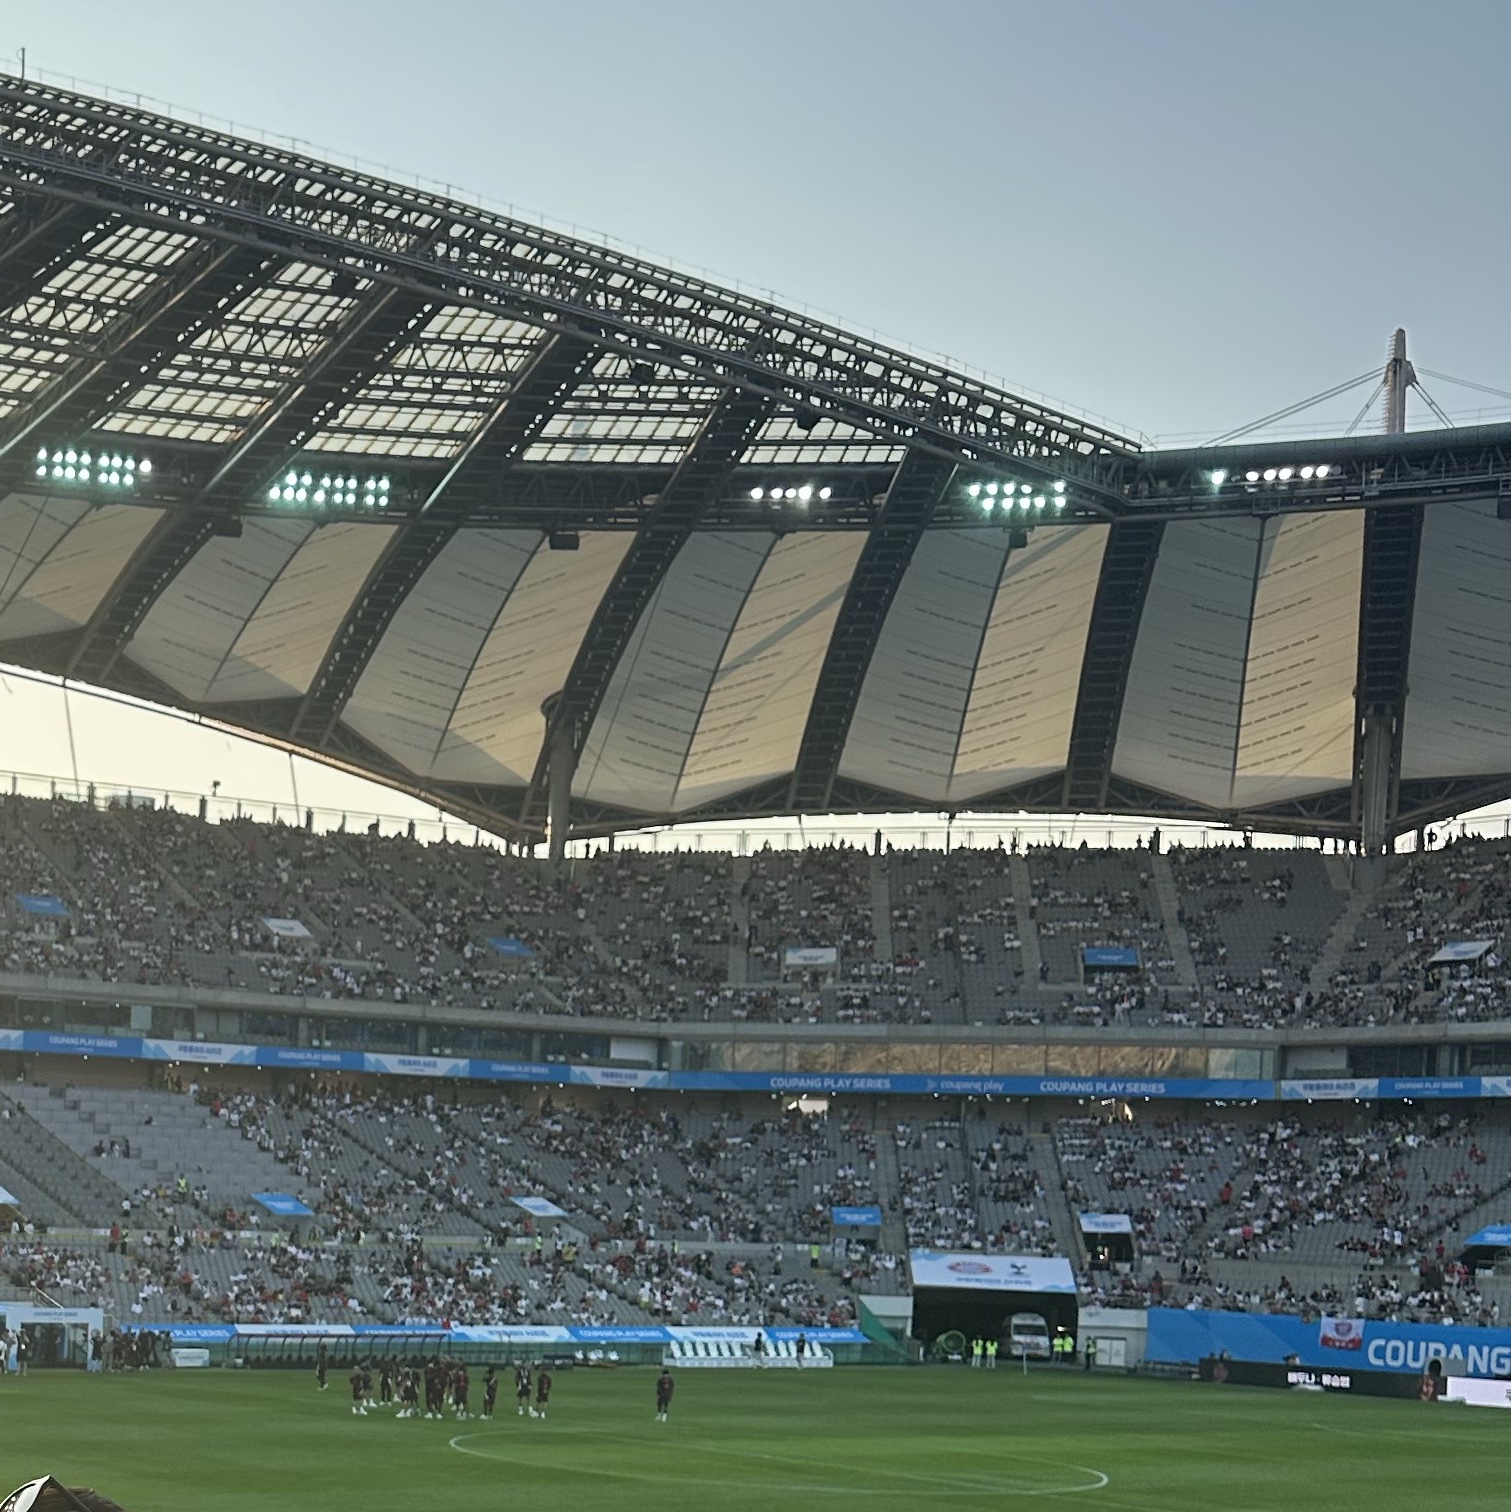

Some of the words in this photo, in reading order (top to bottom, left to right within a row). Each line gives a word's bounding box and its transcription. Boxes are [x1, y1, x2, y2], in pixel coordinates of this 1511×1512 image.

[770, 1077, 822, 1089] COUPANG
[824, 1077, 851, 1089] PLAY
[853, 1078, 891, 1090] SERIES
[983, 1080, 1006, 1092] play
[1040, 1081, 1093, 1092] COUPANG
[1095, 1082, 1125, 1093] PLAY
[1126, 1083, 1165, 1095] SERIES
